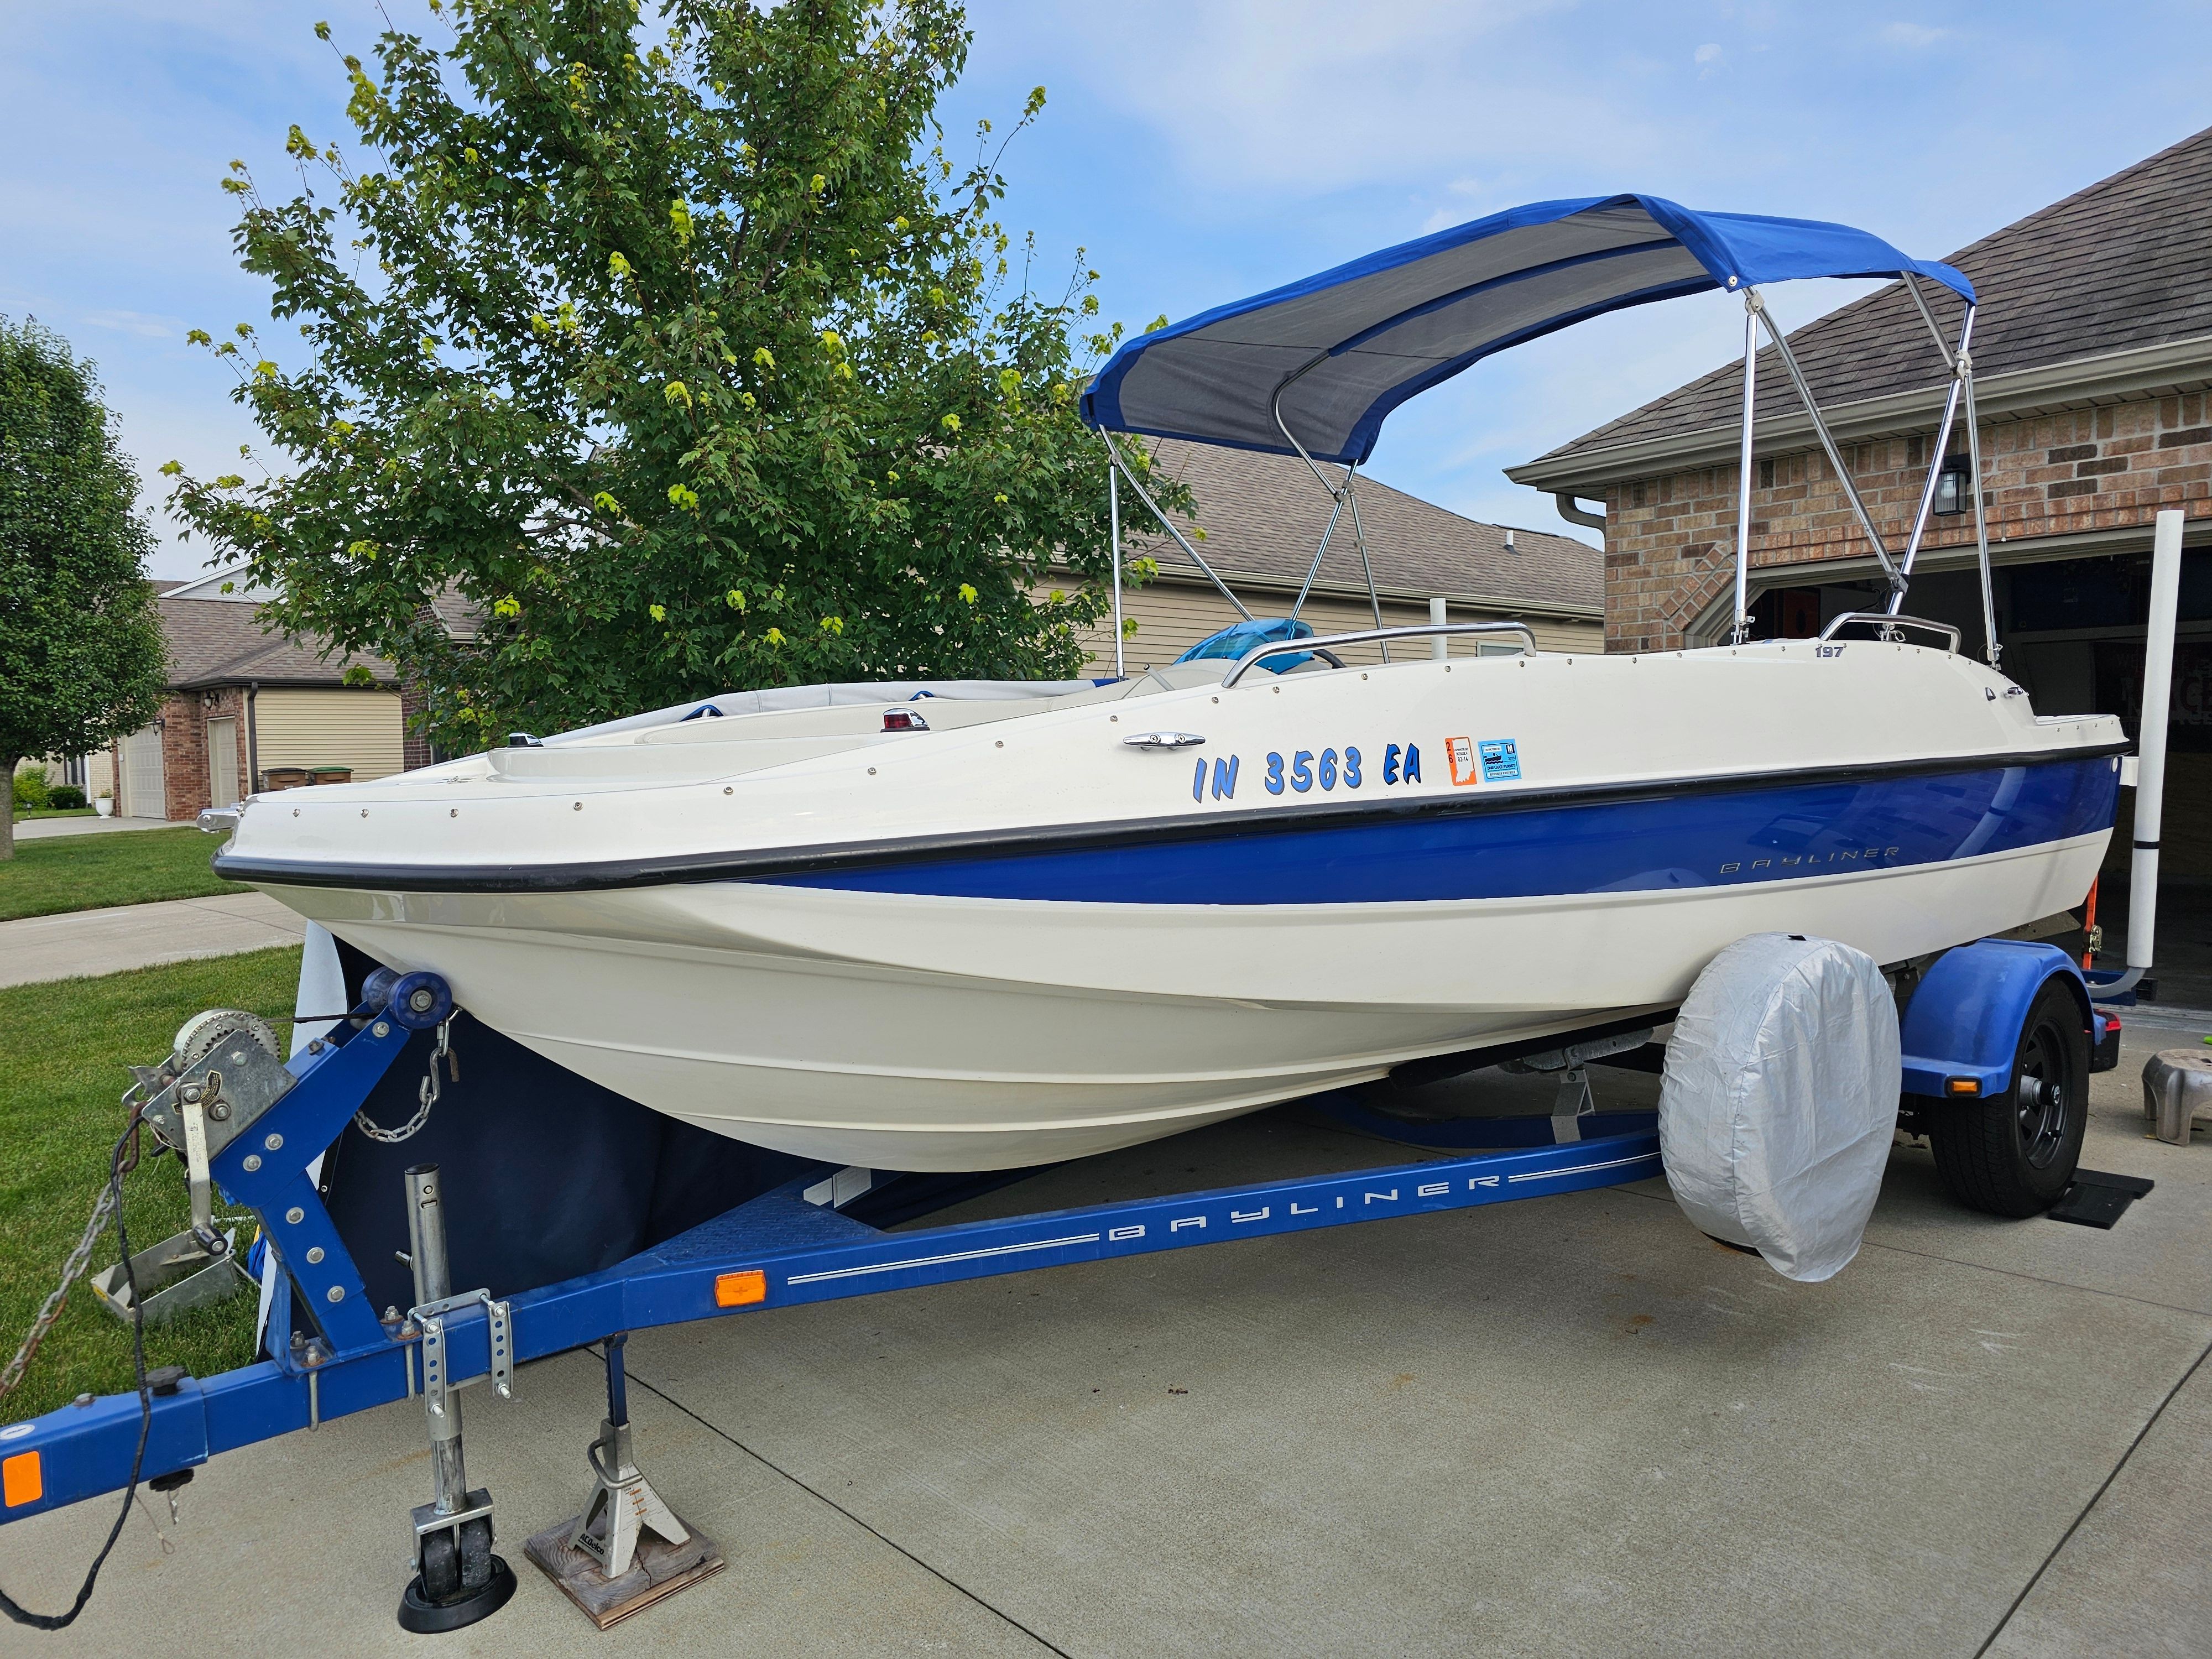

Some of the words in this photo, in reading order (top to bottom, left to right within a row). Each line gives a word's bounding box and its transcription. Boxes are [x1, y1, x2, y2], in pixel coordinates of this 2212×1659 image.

[1815, 646, 1844, 658] 197
[1193, 754, 1239, 804] IN
[1265, 747, 1361, 795] 3563
[1383, 743, 1421, 785] EA
[1720, 847, 1900, 874] BAYLINER
[1109, 1175, 1500, 1241] BAYLINER
[580, 1533, 604, 1554] ACDelco
